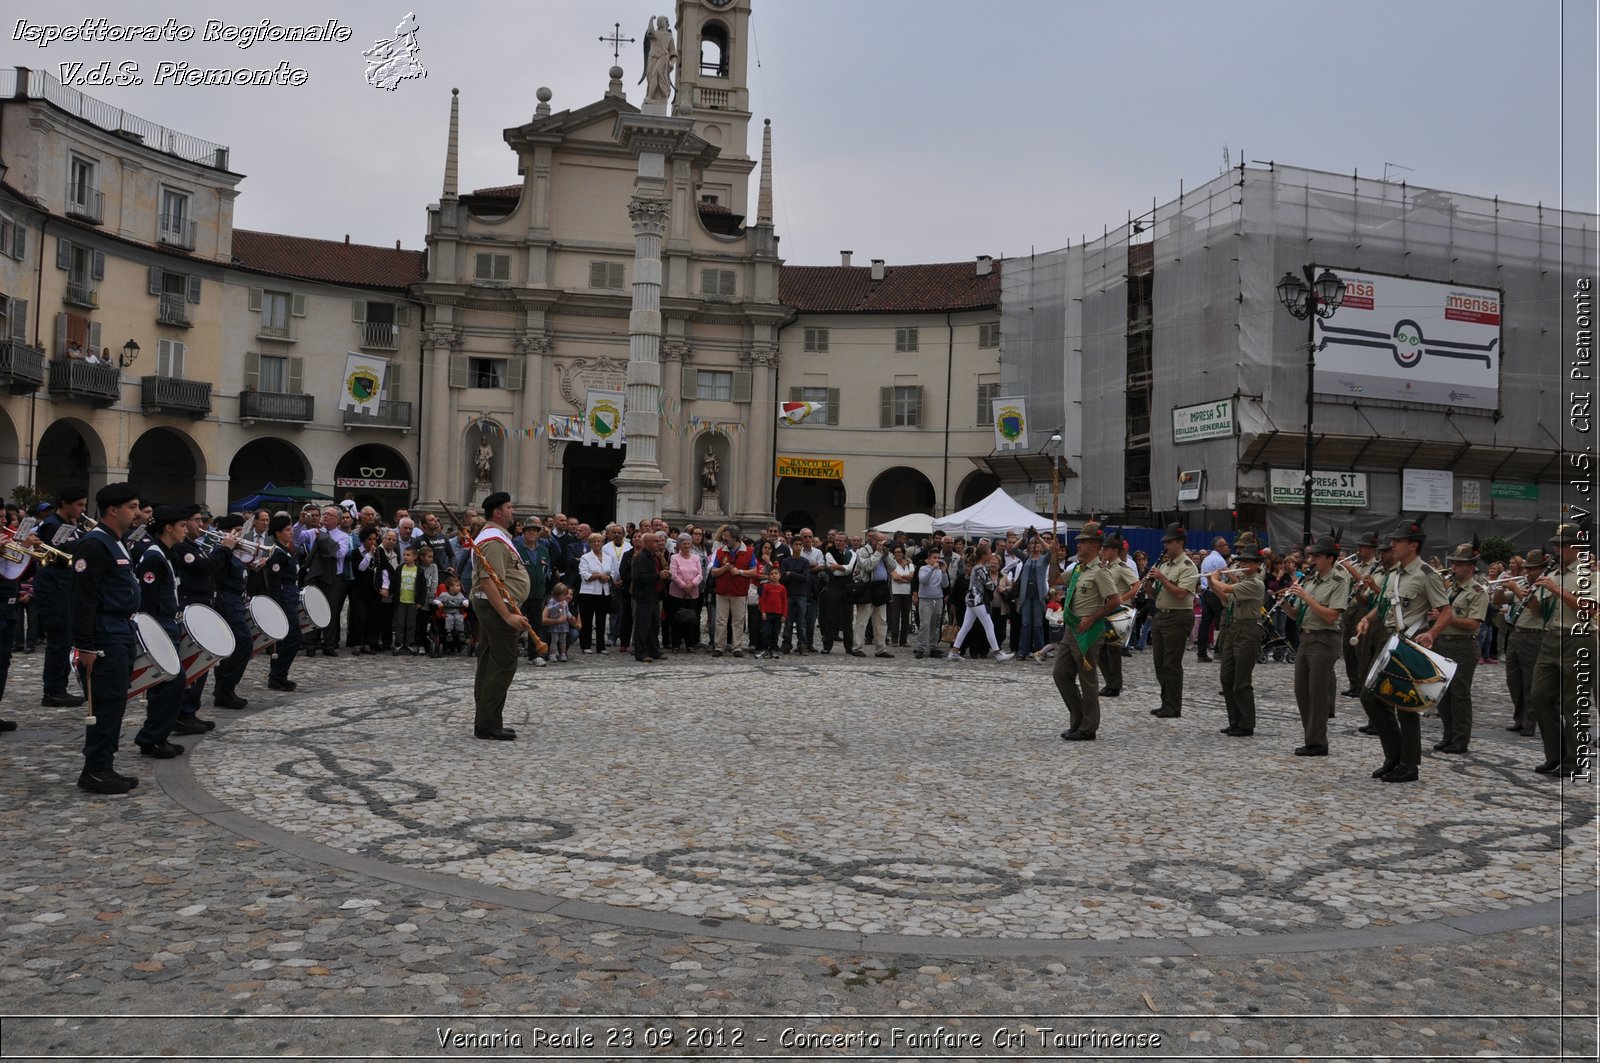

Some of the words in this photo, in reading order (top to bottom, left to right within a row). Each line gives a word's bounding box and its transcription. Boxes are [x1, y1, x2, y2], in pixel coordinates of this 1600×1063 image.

[1347, 283, 1374, 297] nsa
[1450, 296, 1497, 314] mensa
[1190, 409, 1214, 423] IMPRESA
[1216, 403, 1228, 419] ST
[1176, 426, 1198, 436] EDILIZIA
[1200, 421, 1231, 432] GENERALE
[790, 459, 818, 468] BANCO
[779, 466, 840, 478] BENEFICENZA
[338, 479, 366, 487] FOTO
[369, 480, 407, 489] OTTICA
[1340, 474, 1356, 488] ST
[1314, 489, 1364, 498] GENERALE
